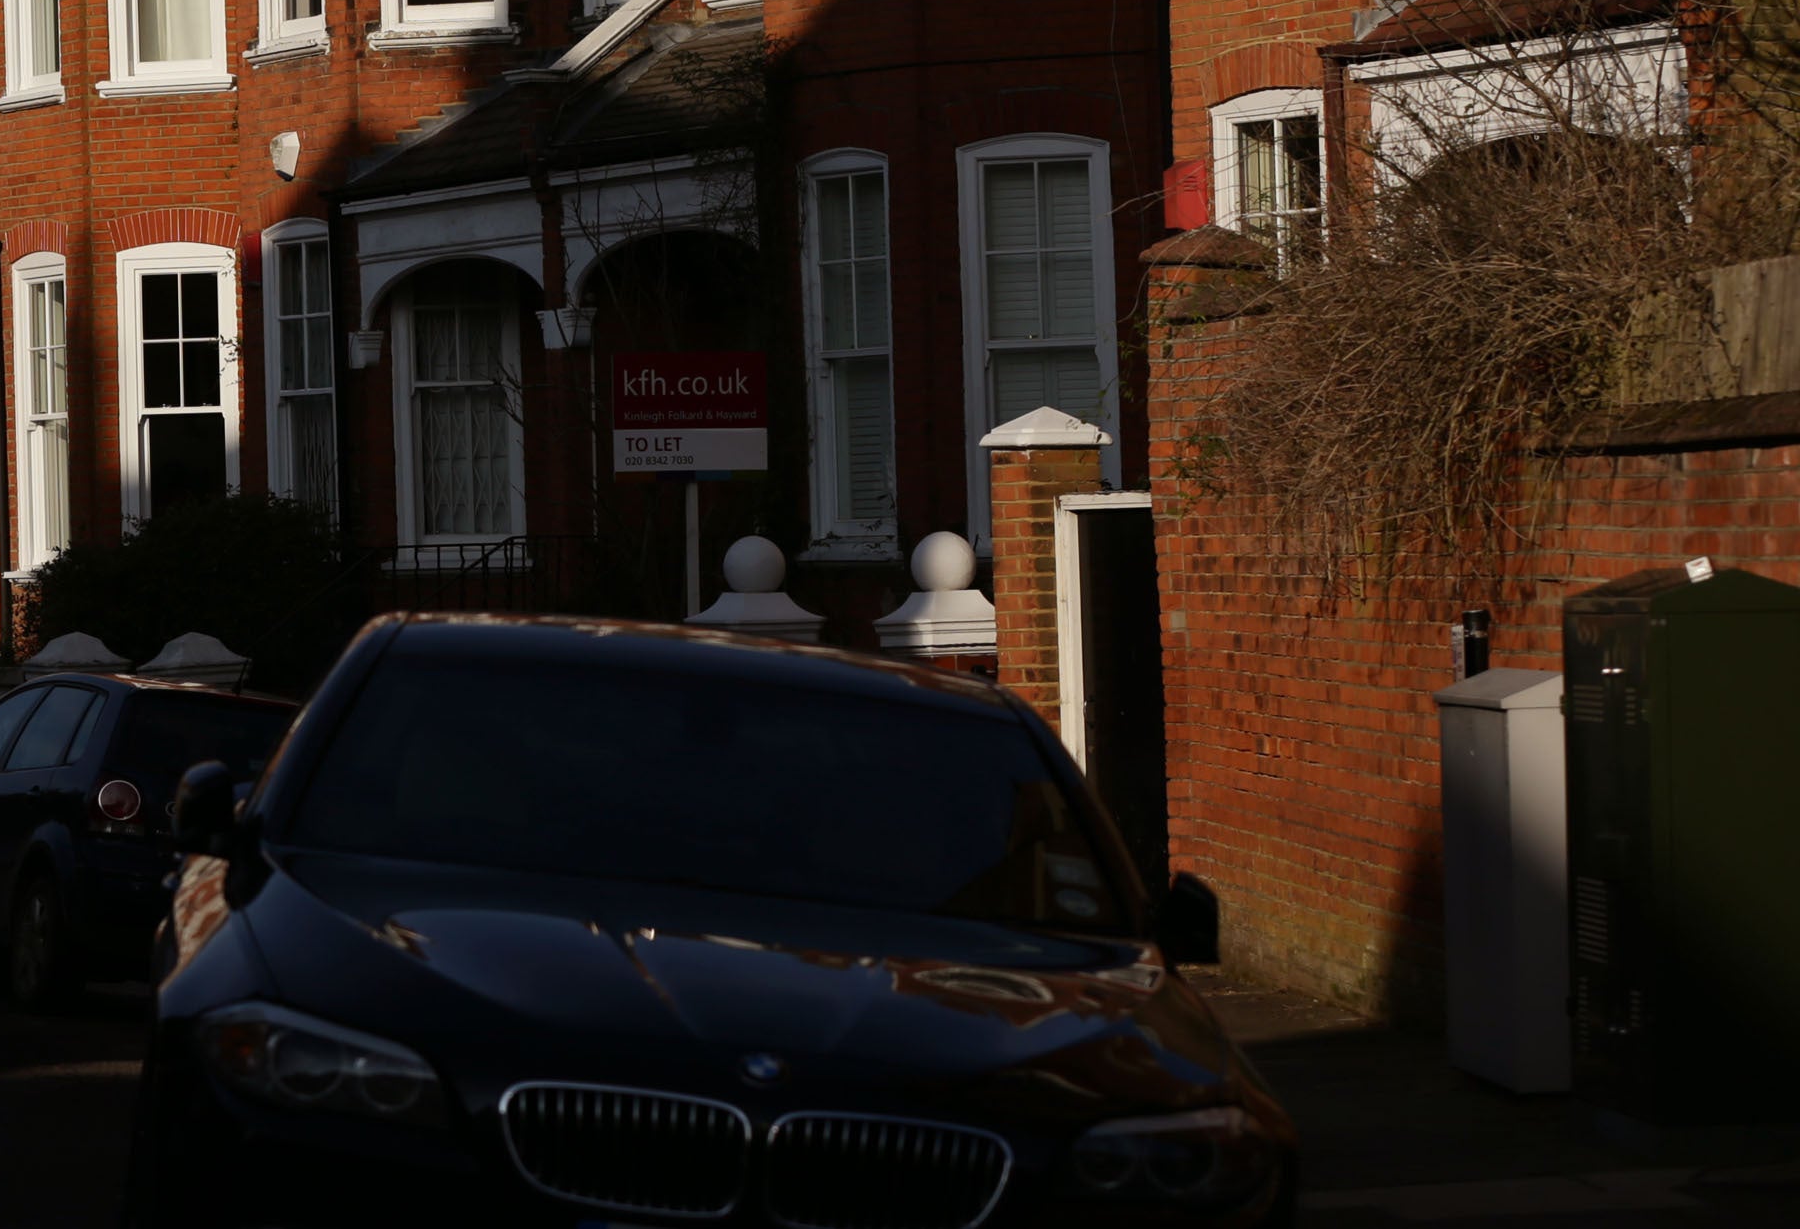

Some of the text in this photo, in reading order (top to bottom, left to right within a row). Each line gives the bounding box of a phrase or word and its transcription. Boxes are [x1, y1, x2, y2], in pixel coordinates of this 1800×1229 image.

[623, 367, 749, 396] kfh.co.uk
[705, 409, 714, 420] &
[625, 436, 682, 452] TO LET
[625, 455, 694, 466] 020 8342 7030
